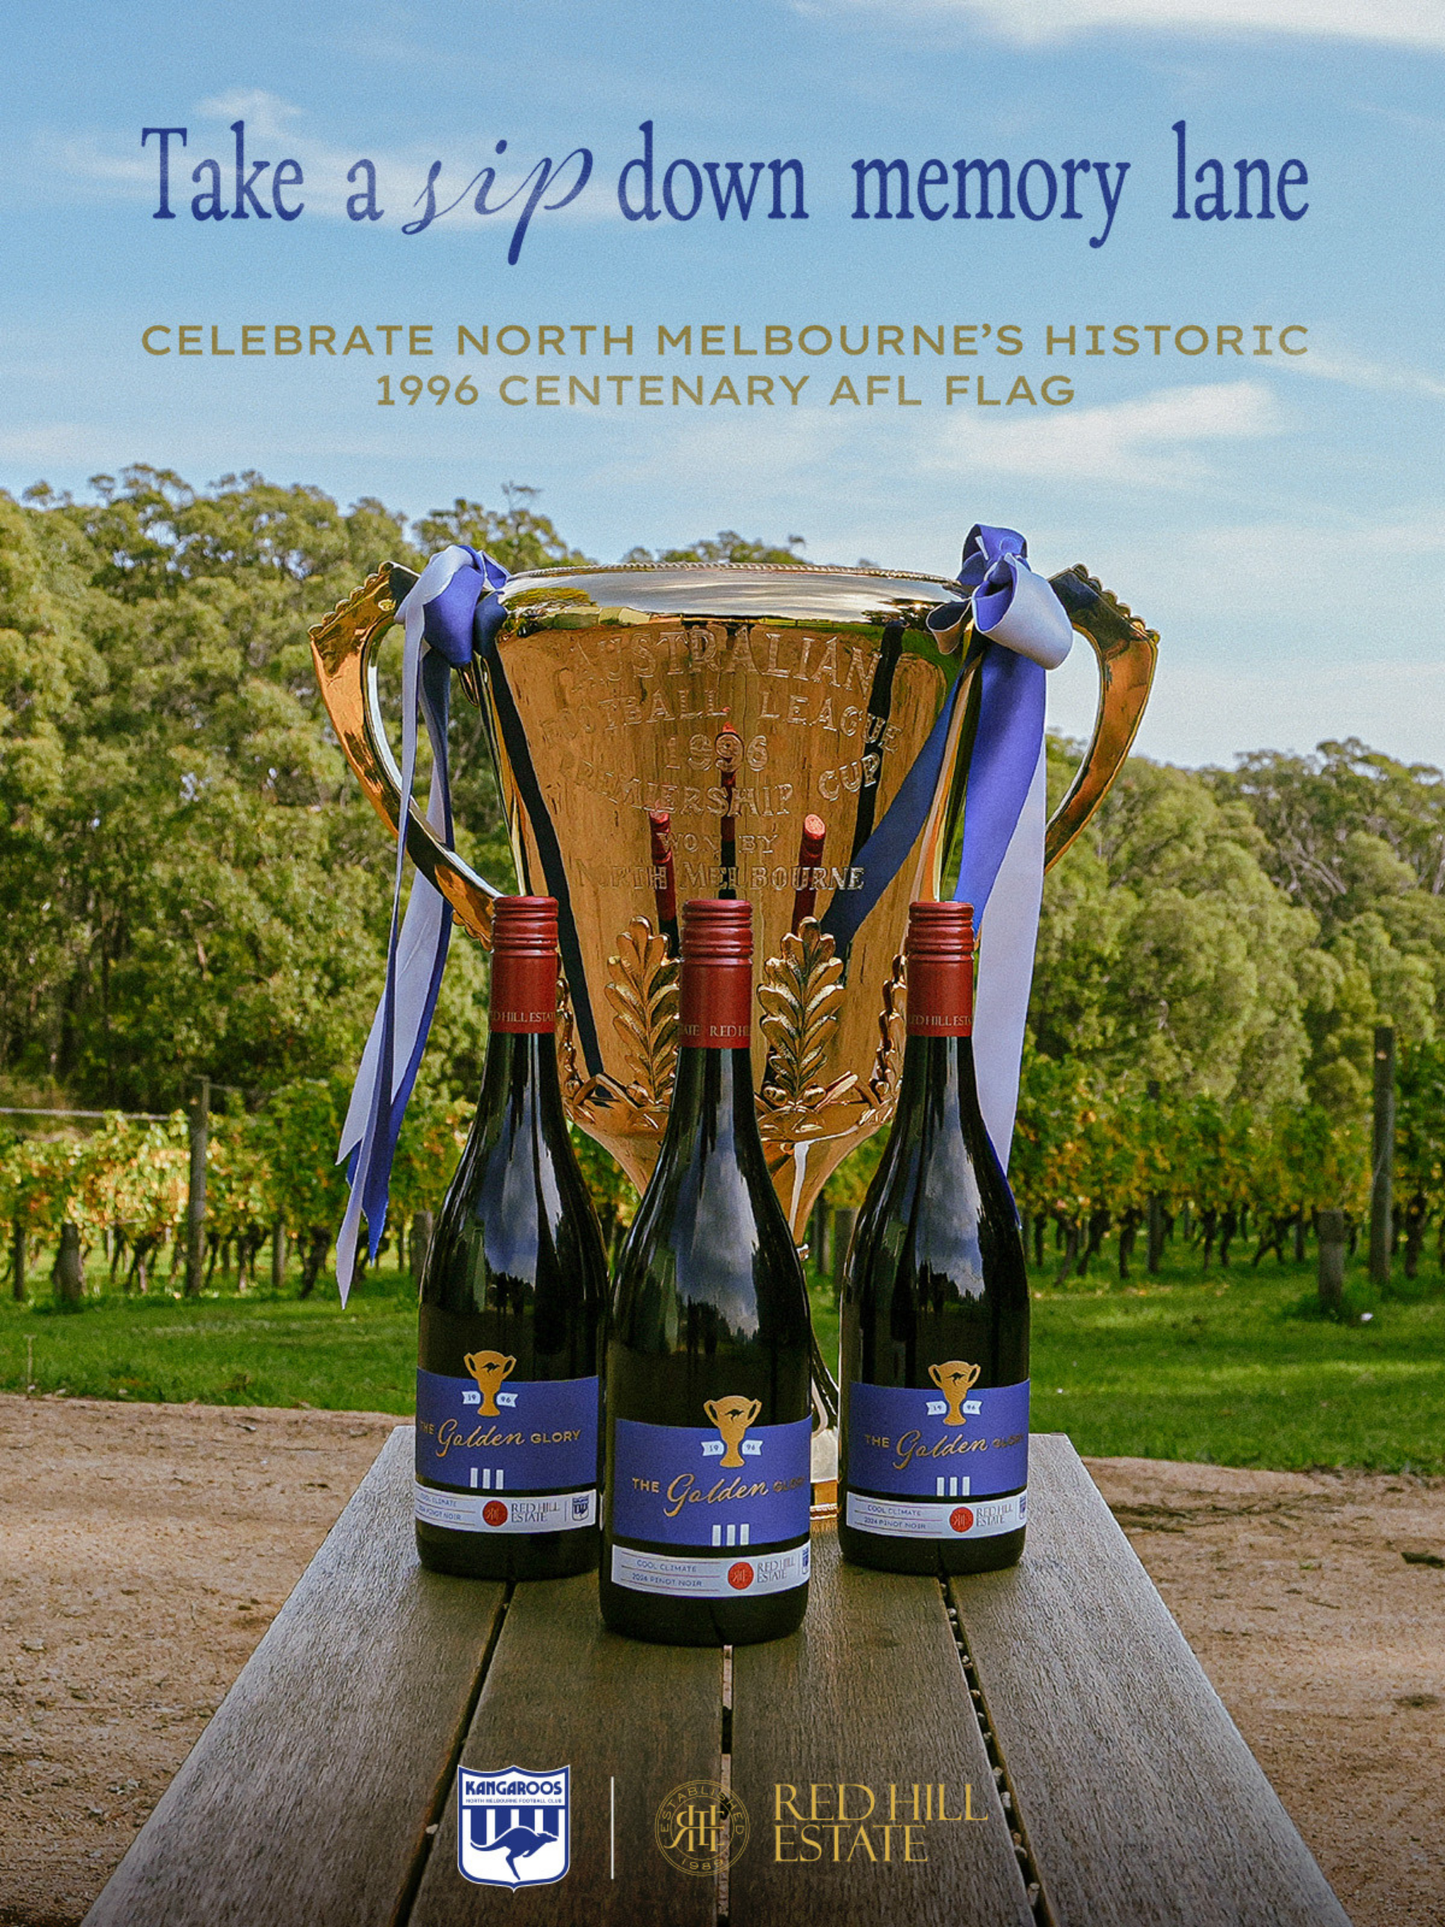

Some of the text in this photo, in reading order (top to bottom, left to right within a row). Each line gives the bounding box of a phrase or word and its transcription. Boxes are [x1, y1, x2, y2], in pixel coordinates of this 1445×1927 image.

[759, 691, 902, 754] LEAGUE
[819, 752, 881, 801] CUP
[739, 834, 778, 854] BY
[435, 1418, 525, 1457] Golden
[530, 1430, 581, 1444] GLORY
[864, 1434, 890, 1448] THE
[892, 1430, 988, 1470] Golden
[632, 1477, 660, 1493] THE
[663, 1473, 769, 1517] Golden
